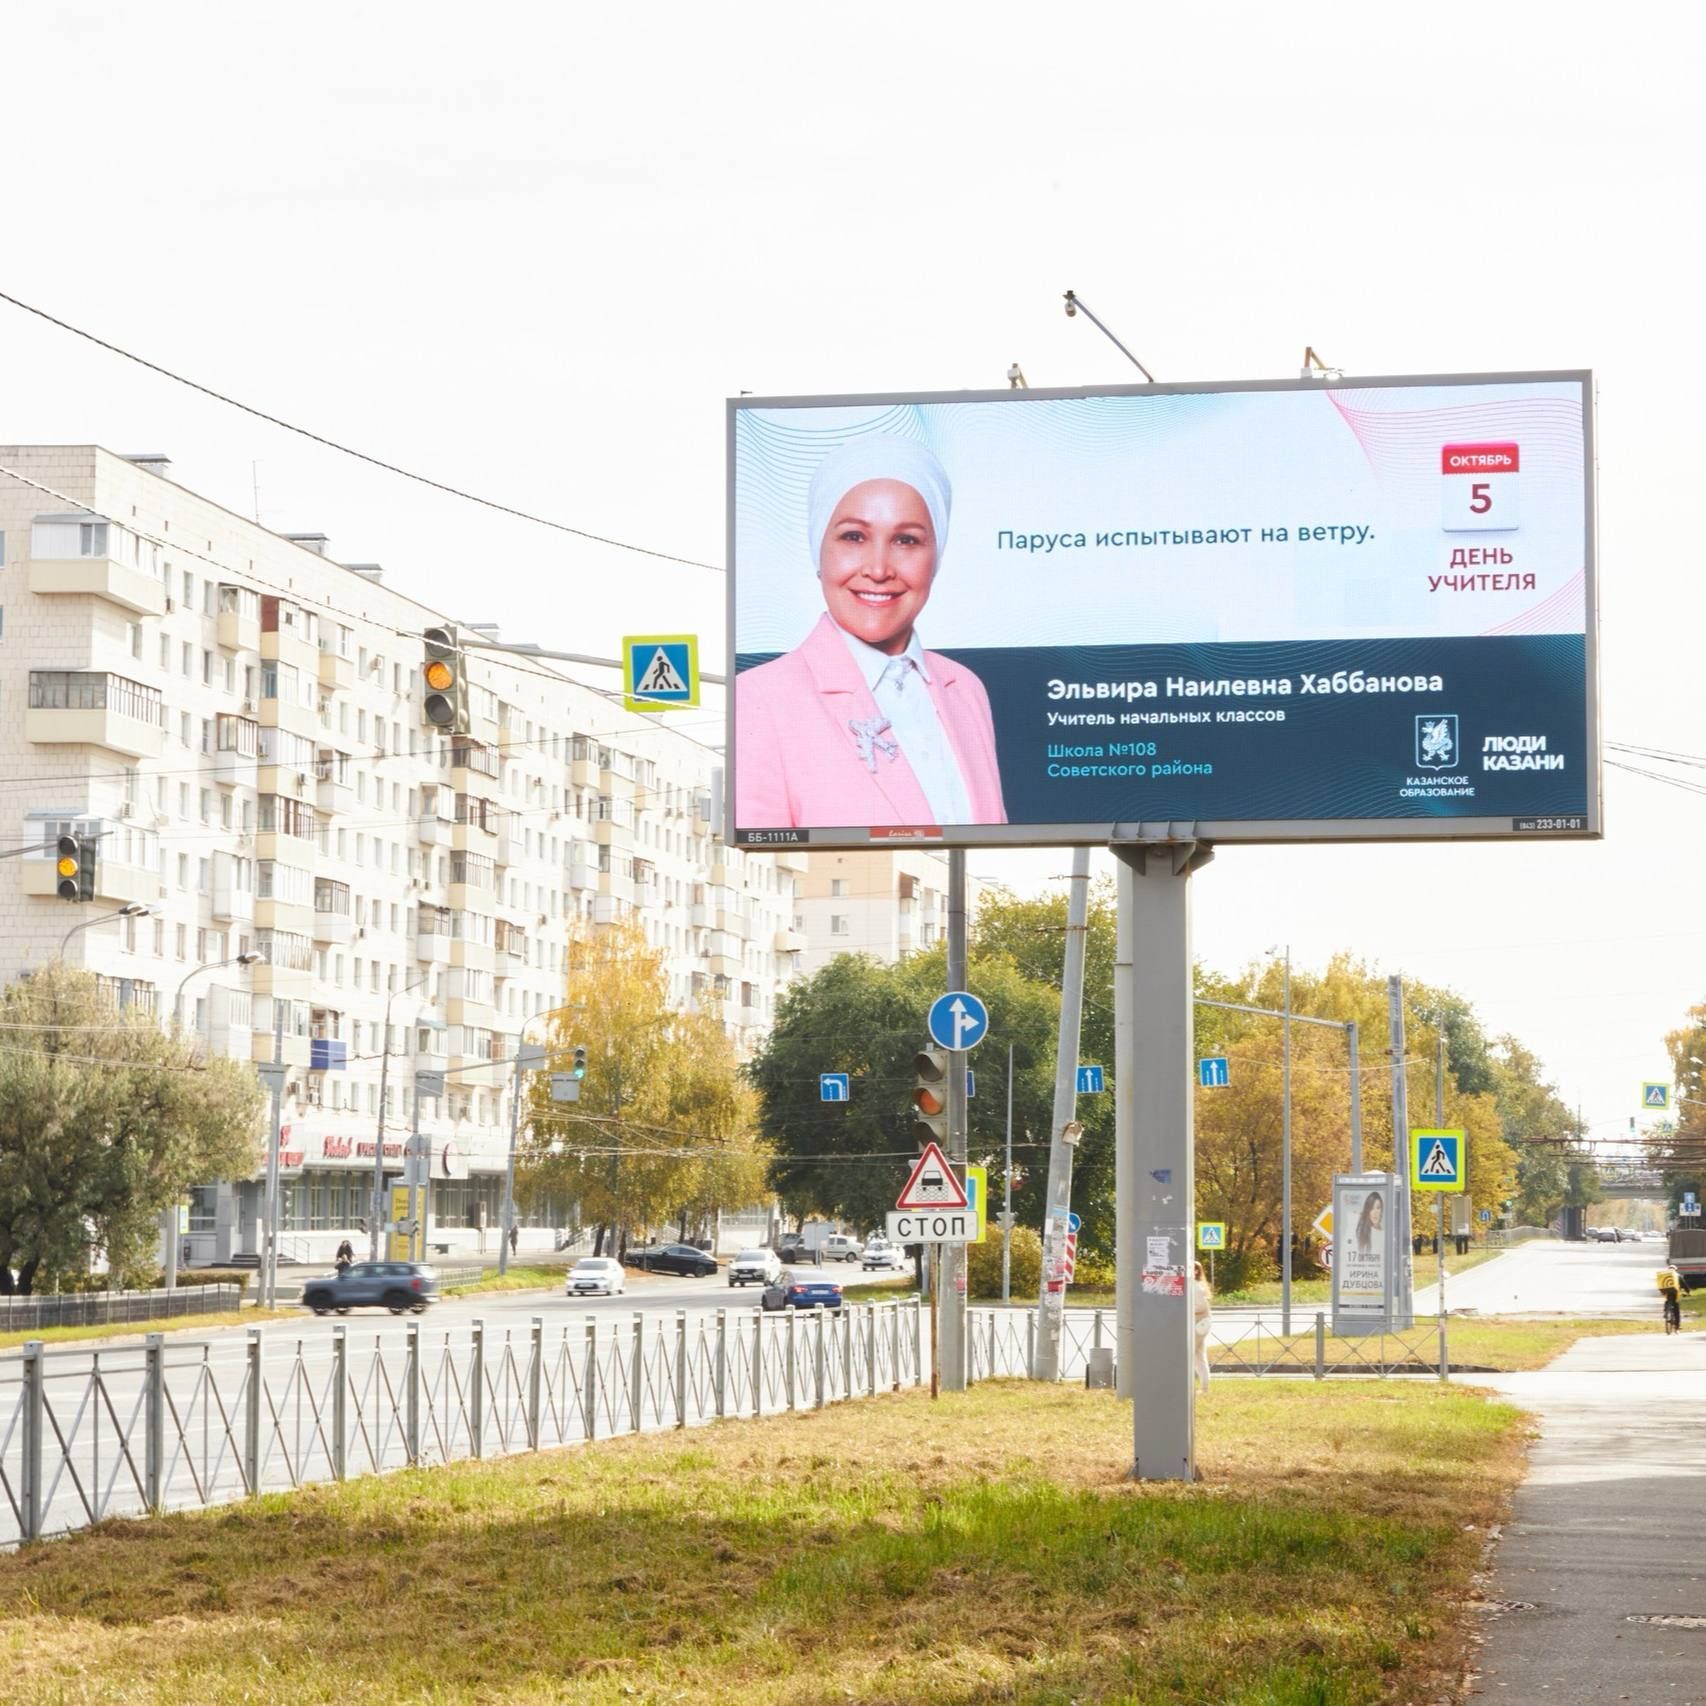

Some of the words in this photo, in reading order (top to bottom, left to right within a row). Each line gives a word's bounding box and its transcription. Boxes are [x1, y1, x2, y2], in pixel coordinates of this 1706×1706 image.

[1449, 454, 1512, 467] ОКТЯБРЬ
[1469, 483, 1492, 514] 5
[998, 530, 1086, 554] Паруса
[1095, 528, 1253, 547] испытывают
[1261, 527, 1289, 543] на
[1298, 525, 1376, 545] ветру.
[1449, 547, 1514, 569] ДЕНЬ
[1427, 573, 1536, 593] УЧИТЕЛЯ
[1047, 678, 1158, 703] Эльвира
[1166, 675, 1292, 697] Наилевна
[1300, 670, 1443, 695] Хаббанова
[1047, 711, 1116, 727] Учитель
[1120, 710, 1212, 725] начальных
[1216, 707, 1286, 722] классов
[1047, 743, 1104, 758] Школа
[1109, 742, 1157, 757] №108
[1482, 735, 1547, 754] ЛЮДИ
[1047, 763, 1147, 777] Советского
[1151, 760, 1213, 779] района
[1483, 754, 1565, 771] КАЗАНИ
[1406, 775, 1470, 786] КАЗАНСКОЕ
[1399, 787, 1475, 798] ОБРАЗОВАНИЕ
[1536, 818, 1581, 830] 233-01-01
[897, 1216, 966, 1237] СТОП
[1347, 1251, 1357, 1262] 17
[1349, 1270, 1379, 1279] ИРИНА
[1342, 1280, 1383, 1290] ДУБЦОВА
